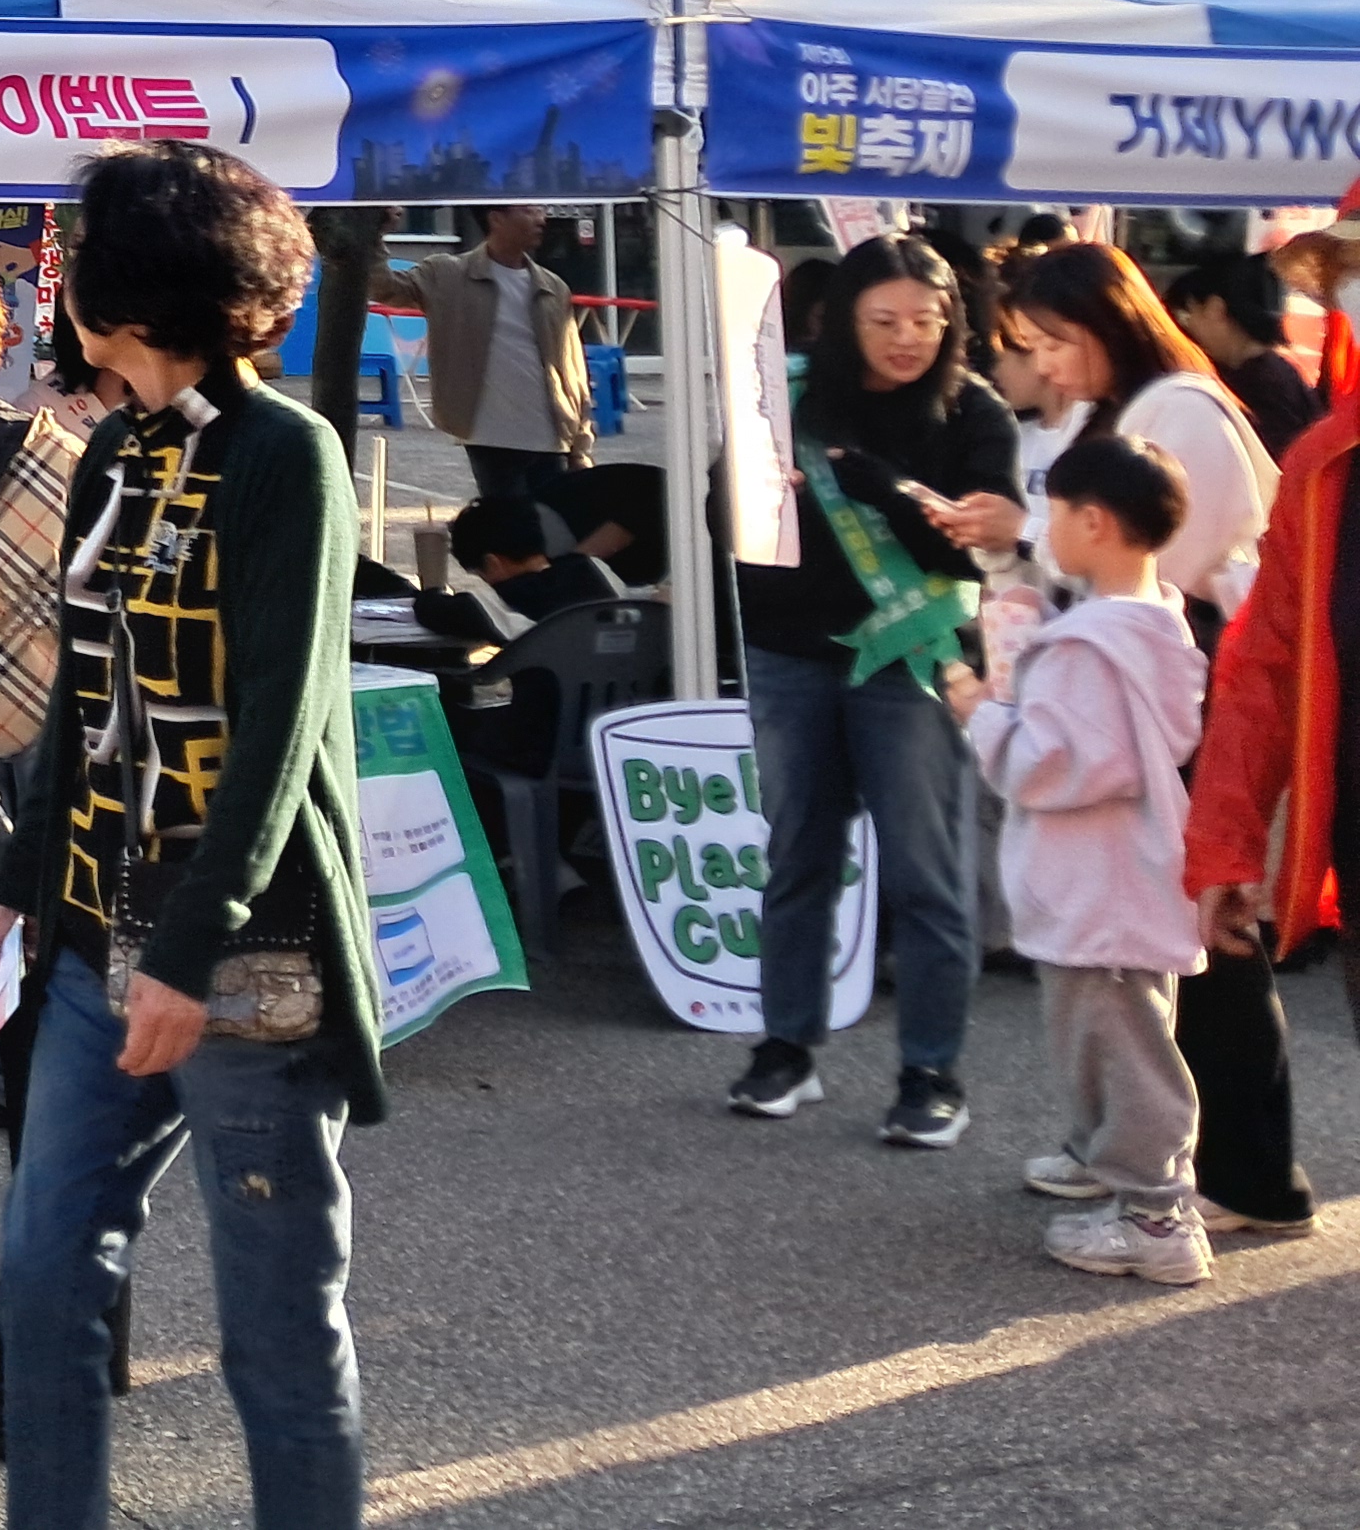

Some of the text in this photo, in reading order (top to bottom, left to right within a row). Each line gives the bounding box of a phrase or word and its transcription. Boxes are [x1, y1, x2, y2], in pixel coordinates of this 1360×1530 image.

[799, 71, 859, 107] 아주
[798, 111, 974, 178] 빛축제
[622, 756, 737, 826] Bye
